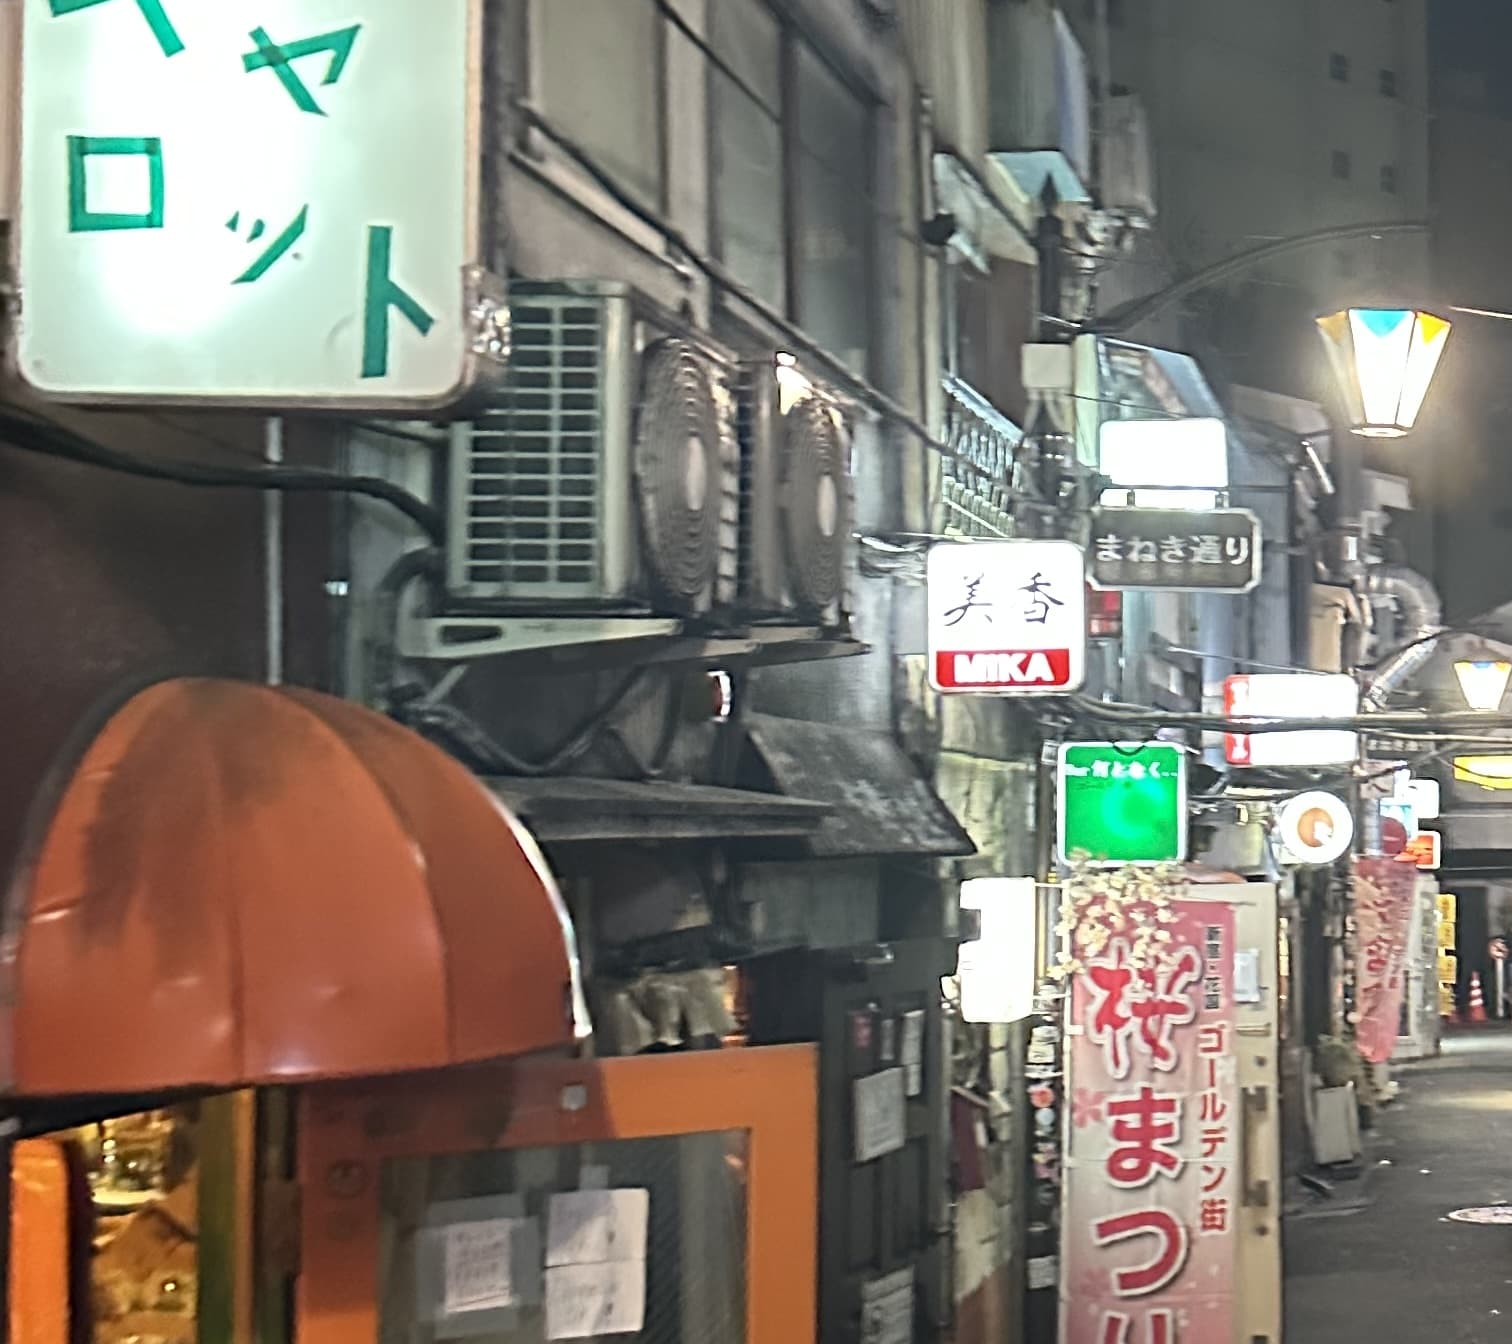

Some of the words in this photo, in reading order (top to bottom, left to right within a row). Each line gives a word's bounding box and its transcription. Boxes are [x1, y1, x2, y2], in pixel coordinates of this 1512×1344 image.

[1096, 533, 1249, 565] まねき通り
[943, 571, 1065, 627] 美香
[953, 652, 1055, 683] MIKA
[1198, 1022, 1228, 1233] ゴールデン街
